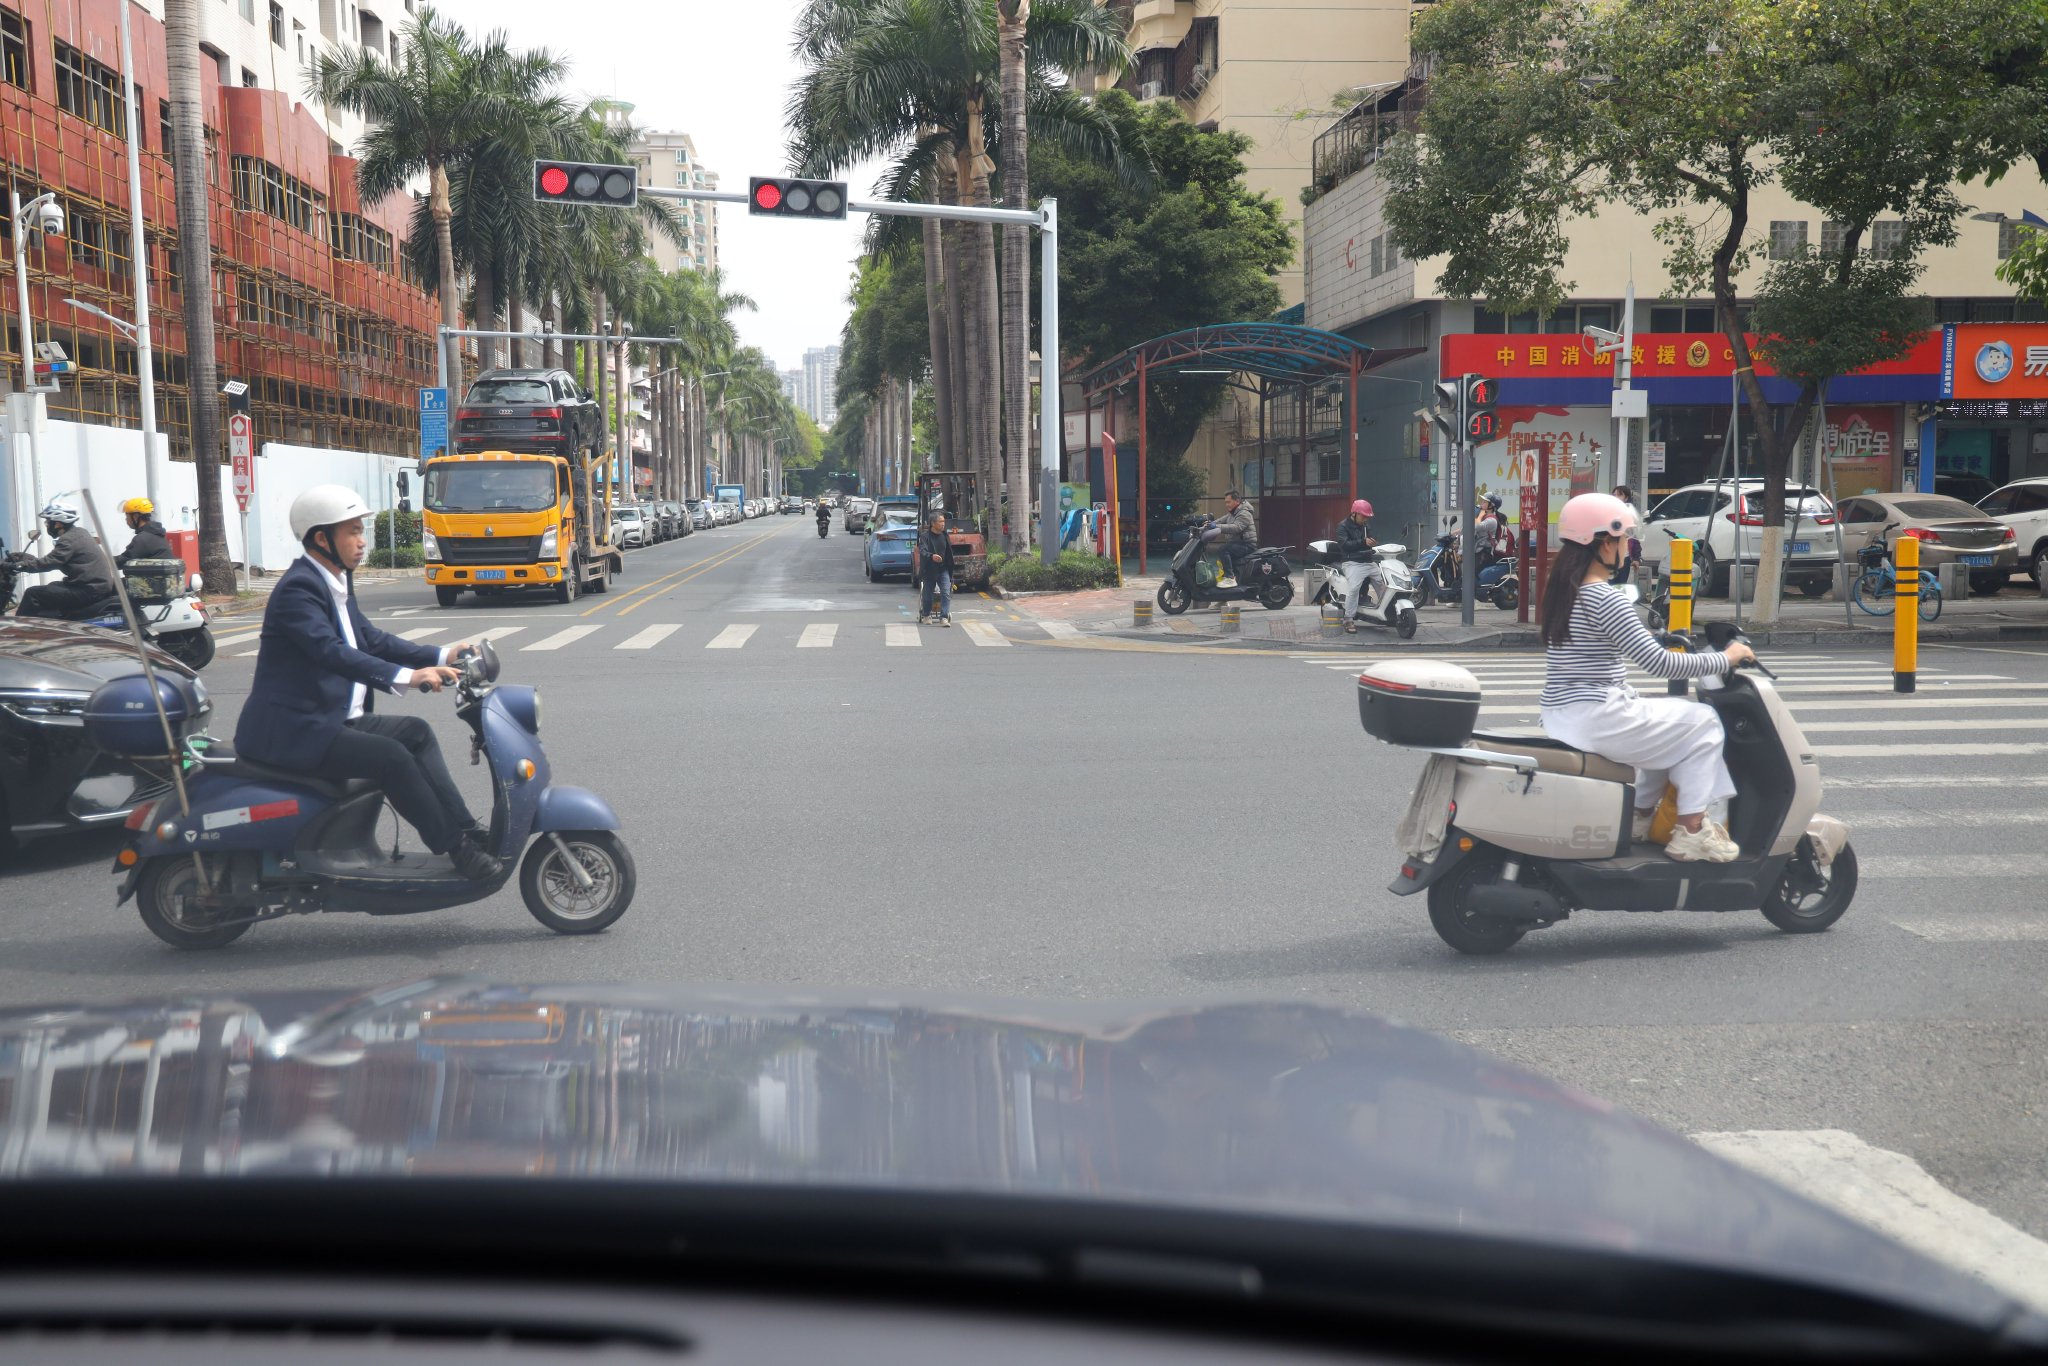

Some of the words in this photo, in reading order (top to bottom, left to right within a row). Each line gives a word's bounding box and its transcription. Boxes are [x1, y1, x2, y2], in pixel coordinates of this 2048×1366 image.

[1497, 346, 1675, 366] 中国消防救援
[2024, 345, 2048, 377] 易
[423, 391, 434, 409] P
[1471, 416, 1492, 434] 37
[236, 438, 246, 475] 行人优先
